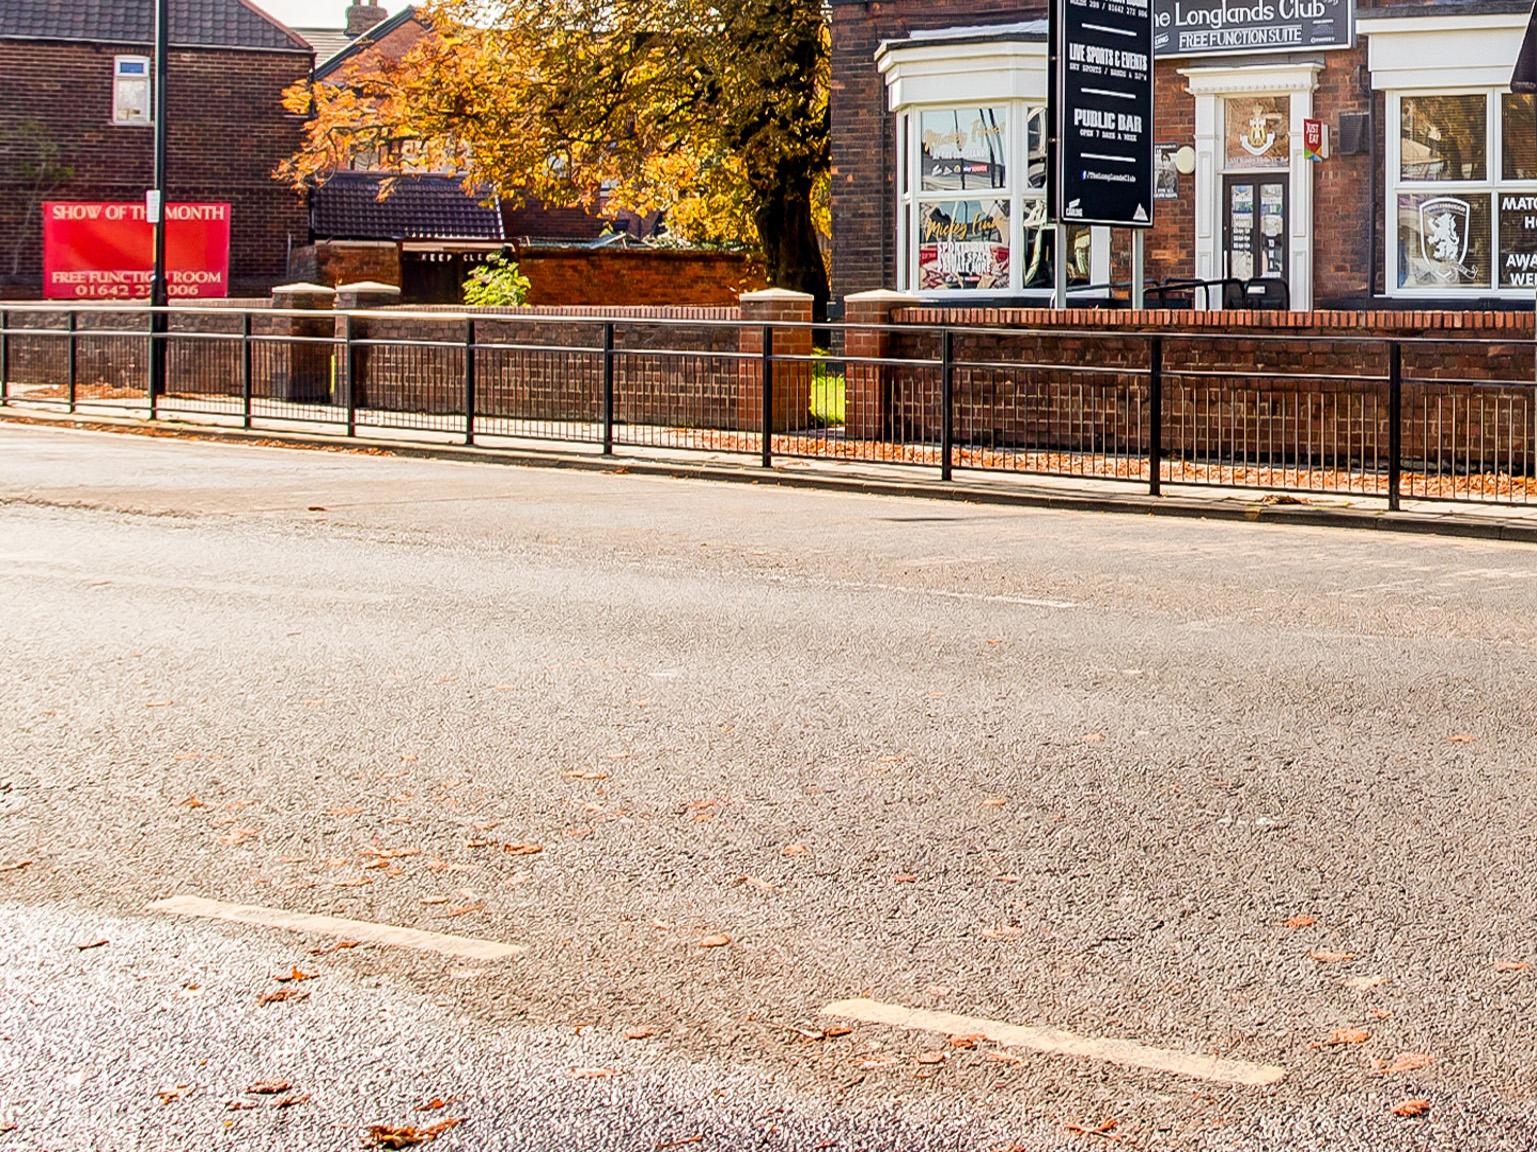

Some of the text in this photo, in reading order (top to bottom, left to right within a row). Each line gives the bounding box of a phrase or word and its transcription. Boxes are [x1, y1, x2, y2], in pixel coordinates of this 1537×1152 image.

[1179, 31, 1208, 48] FREE
[1209, 29, 1267, 46] FUNCTION
[1268, 27, 1303, 43] SUITE
[1069, 43, 1085, 62] LIVE
[1086, 45, 1114, 67] SPORTS
[1121, 51, 1148, 72] EVENTS
[1074, 108, 1143, 134] PUBLIC BAR
[1305, 121, 1319, 134] JUST
[1095, 130, 1100, 138] 7
[1308, 134, 1319, 145] EAT
[52, 204, 101, 220] SHOW
[104, 204, 128, 219] OF
[129, 204, 147, 220] TH
[165, 205, 225, 221] MONTH
[421, 253, 452, 263] KEEP
[52, 271, 87, 284] FREE
[174, 272, 222, 284] ROOM
[75, 284, 129, 296] 01642
